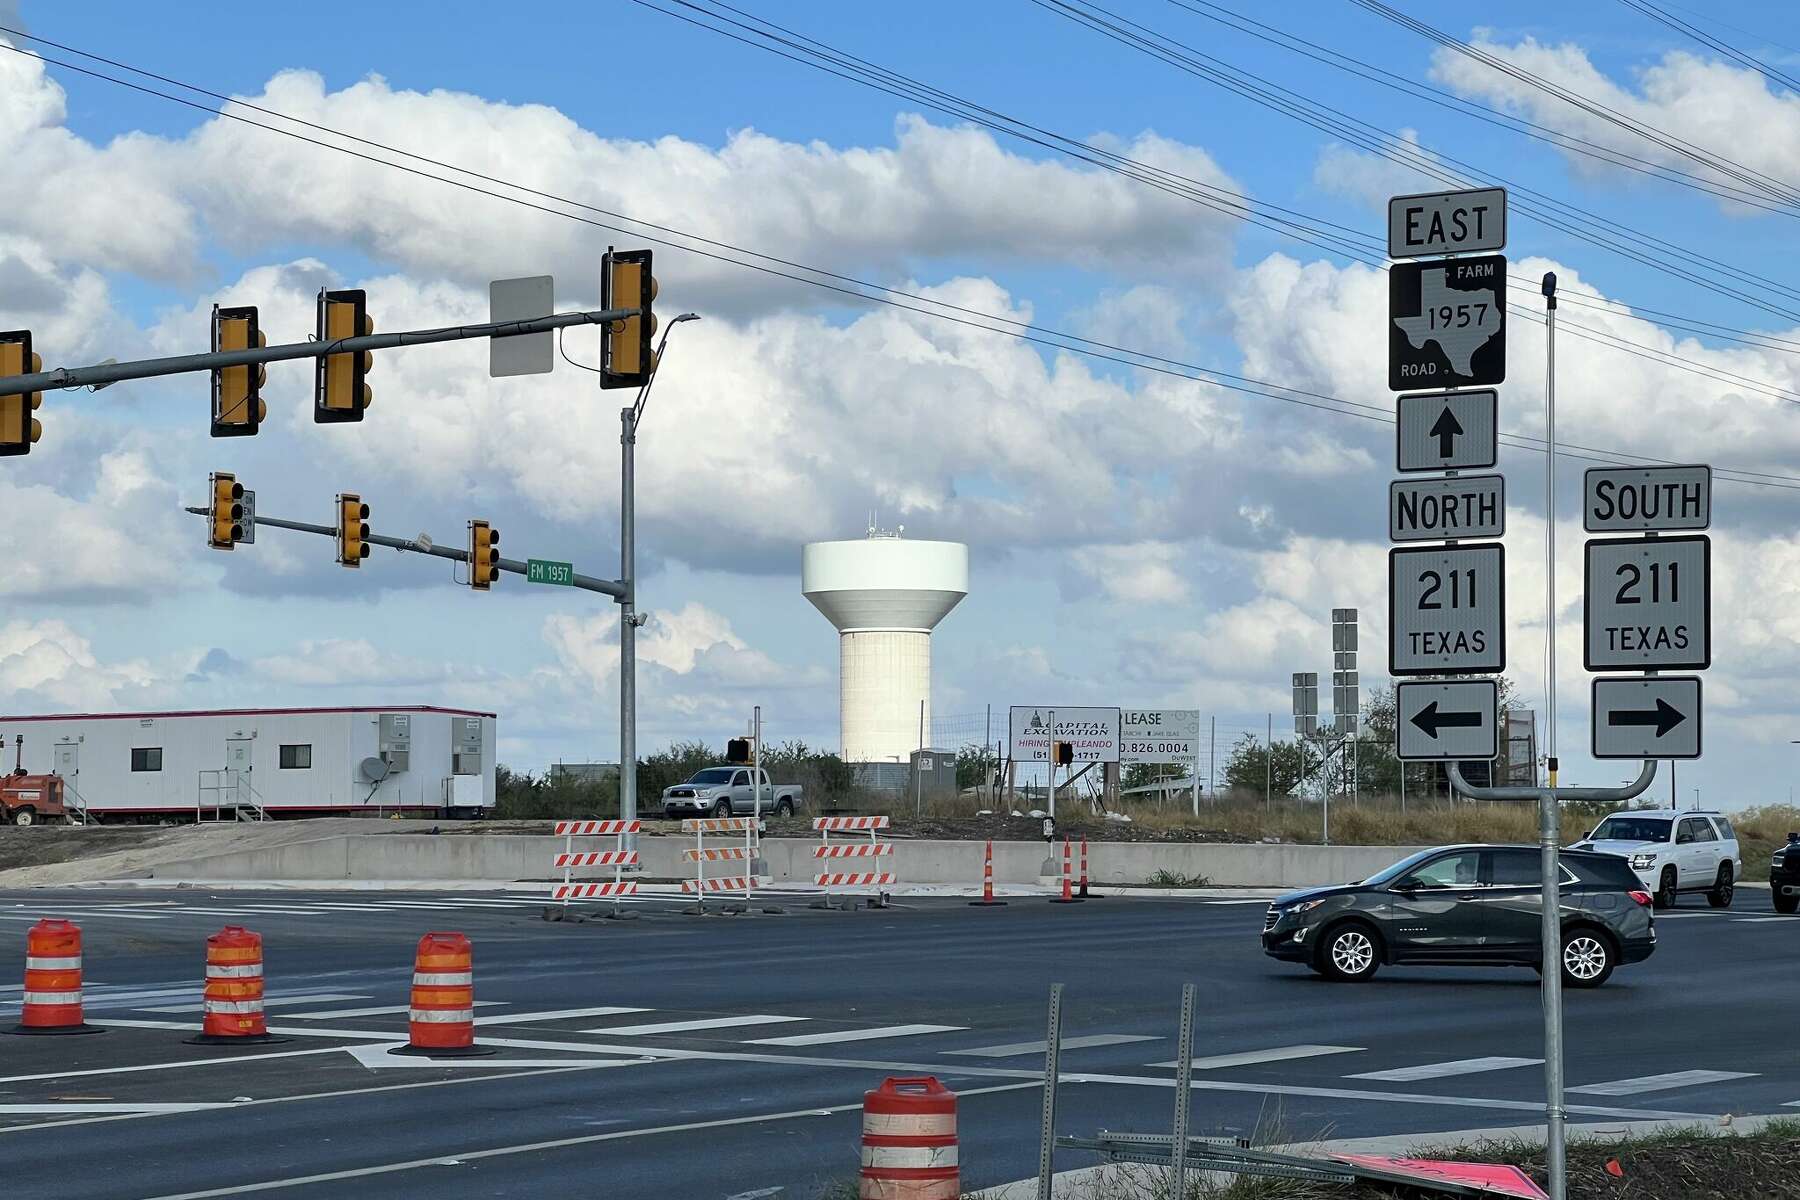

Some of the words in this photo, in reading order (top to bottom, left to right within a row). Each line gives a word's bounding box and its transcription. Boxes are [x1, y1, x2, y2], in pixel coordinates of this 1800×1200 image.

[1405, 206, 1488, 246] EAST
[1457, 263, 1494, 279] FARM
[1428, 303, 1488, 330] 1957
[1401, 362, 1437, 377] ROAD
[1398, 491, 1496, 530] NORTH
[1594, 480, 1700, 521] SOUTH
[531, 564, 543, 579] FM
[548, 566, 568, 581] 1957
[1615, 561, 1680, 604] 211
[1418, 568, 1476, 610] 211
[1409, 630, 1486, 655] TEXAS
[1605, 625, 1689, 651] TEXAS
[1125, 712, 1162, 725] LEASE
[1018, 739, 1050, 748] HIRING
[1023, 728, 1109, 736] EXCAVATION
[1120, 743, 1189, 753] 0.826.0004
